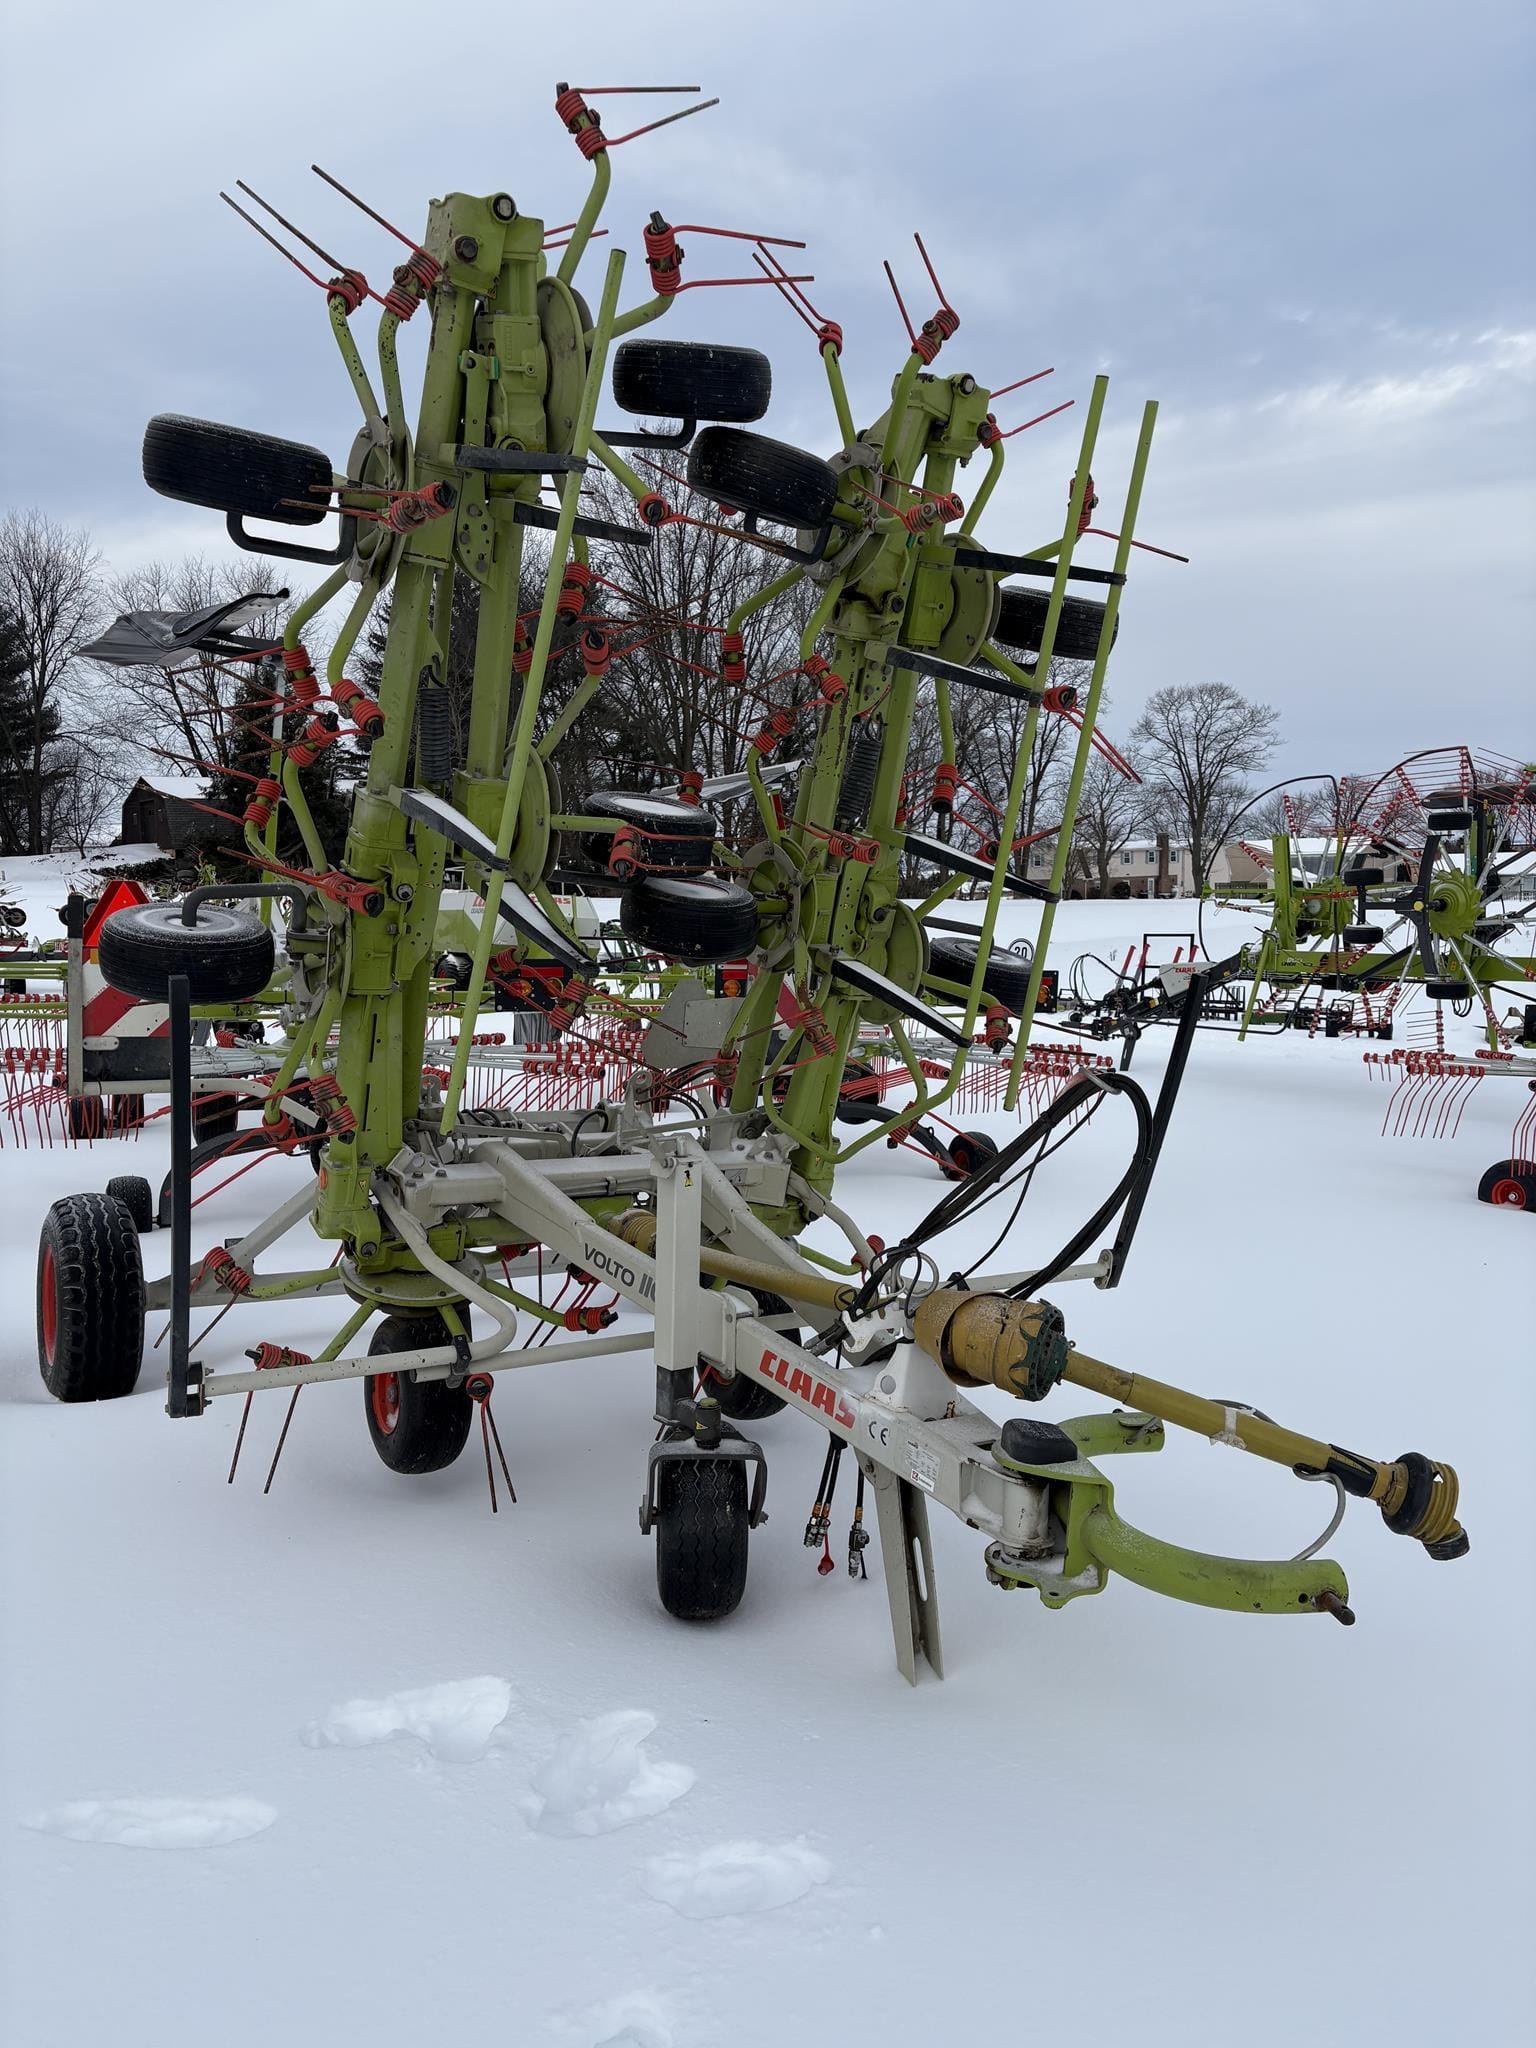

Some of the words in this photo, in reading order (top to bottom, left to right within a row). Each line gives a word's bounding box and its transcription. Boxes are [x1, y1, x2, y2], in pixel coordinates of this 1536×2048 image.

[1014, 946, 1028, 959] 20
[584, 1242, 636, 1288] VOLTO
[758, 1349, 857, 1430] CLAAS
